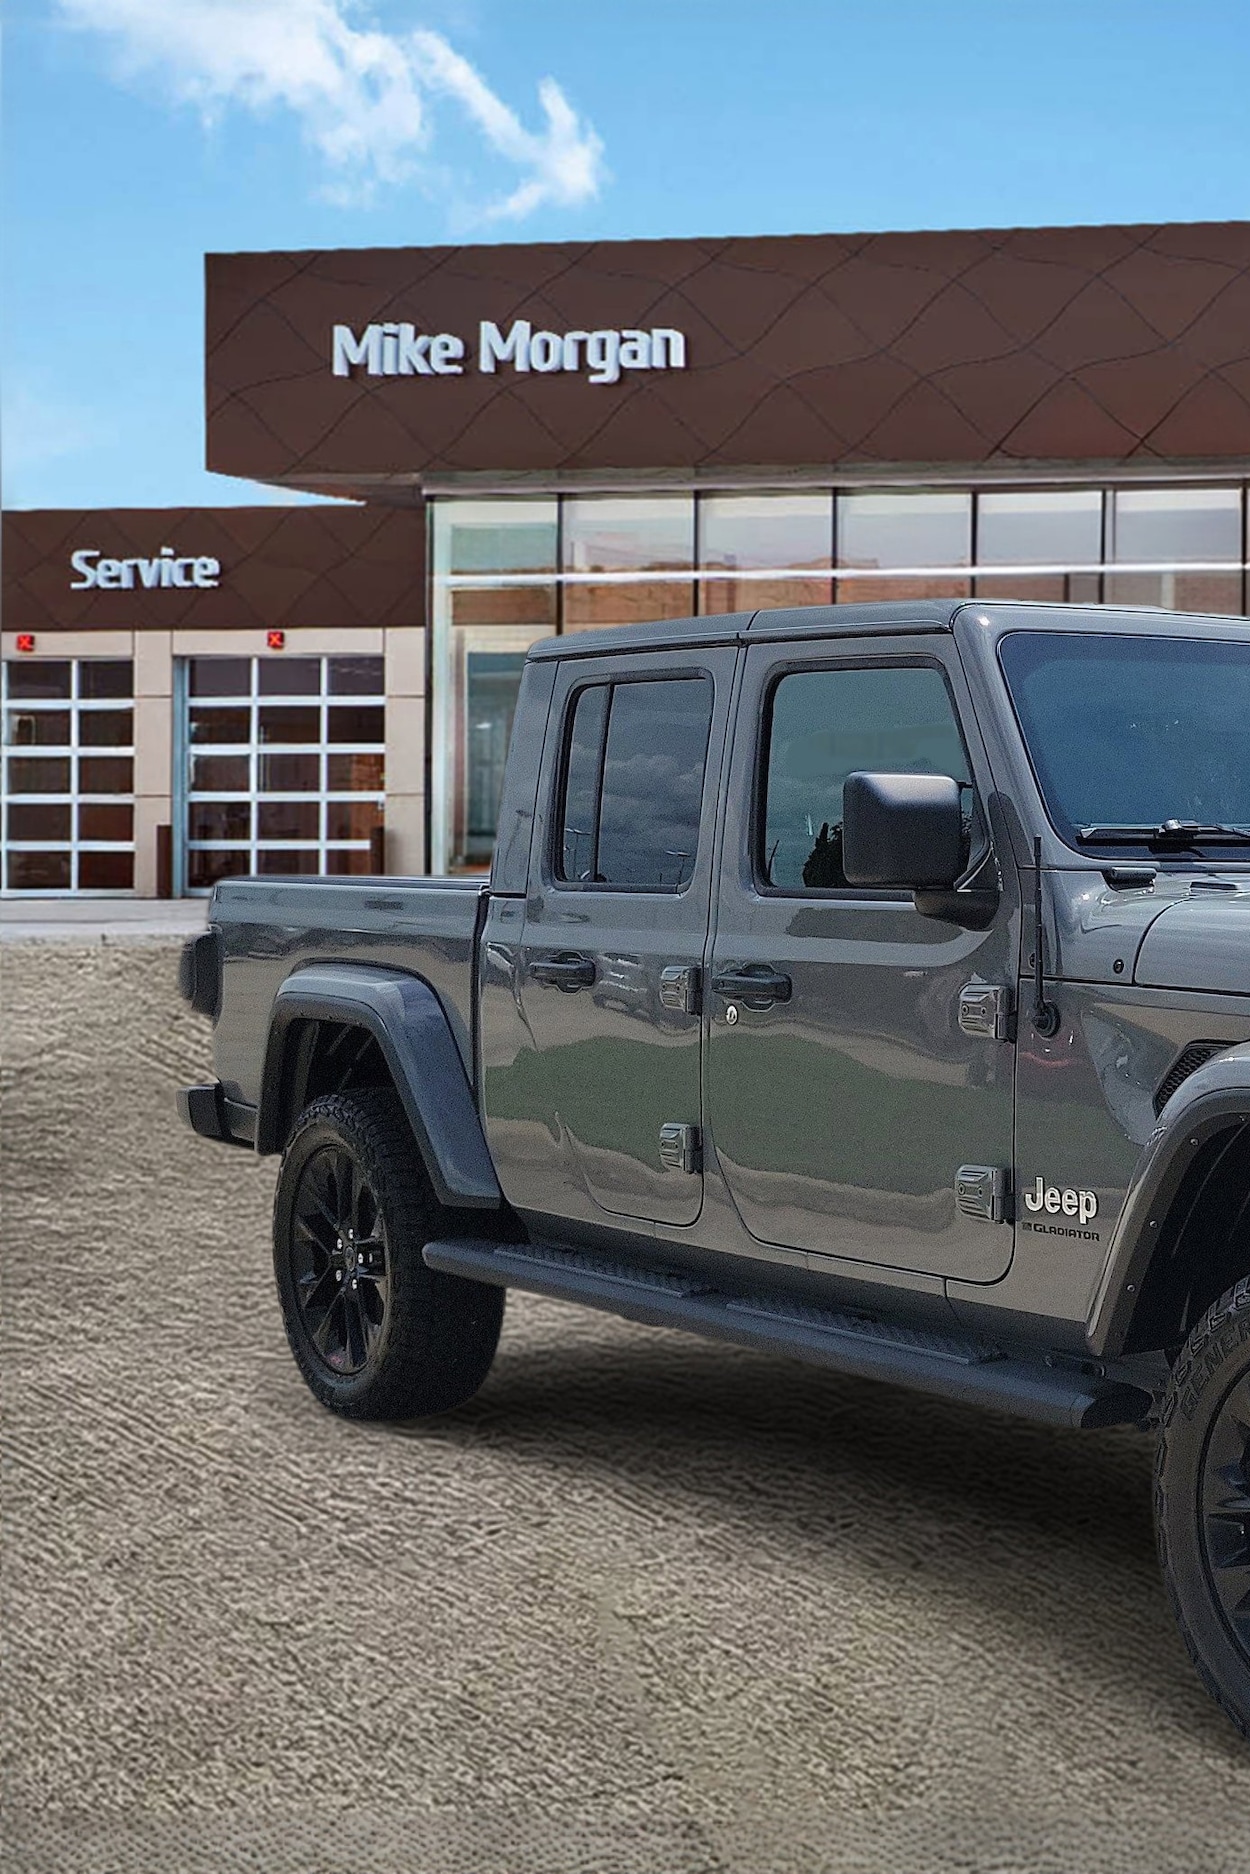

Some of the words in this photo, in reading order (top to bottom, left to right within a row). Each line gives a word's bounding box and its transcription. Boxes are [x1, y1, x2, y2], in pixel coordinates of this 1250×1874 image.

[332, 322, 465, 377] Mike
[479, 319, 687, 384] Morgan
[70, 546, 220, 590] Service
[1024, 1176, 1098, 1225] Jeep
[1033, 1223, 1101, 1242] GLADIATOR
